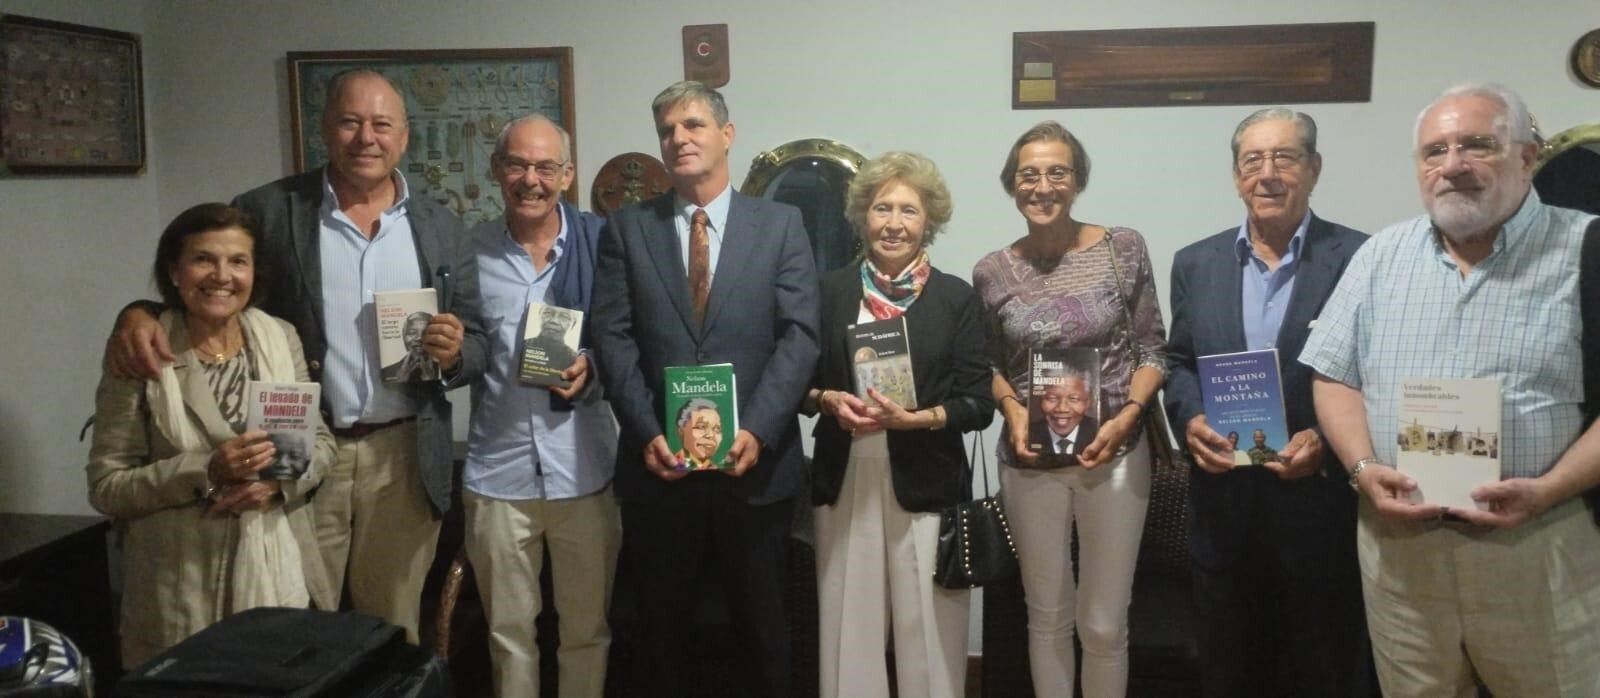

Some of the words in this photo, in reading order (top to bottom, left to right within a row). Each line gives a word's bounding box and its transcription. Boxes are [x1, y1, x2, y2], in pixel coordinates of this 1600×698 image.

[1033, 353, 1042, 361] LA
[1033, 361, 1064, 369] SONRISA
[1033, 369, 1042, 377] DE
[1033, 376, 1065, 385] MANDELA
[1211, 376, 1224, 384] EL
[1225, 372, 1266, 382] CAMINO
[672, 380, 727, 394] Mandela
[1238, 383, 1251, 391] LA
[260, 391, 268, 402] El
[270, 391, 300, 404] legado
[302, 392, 313, 404] de
